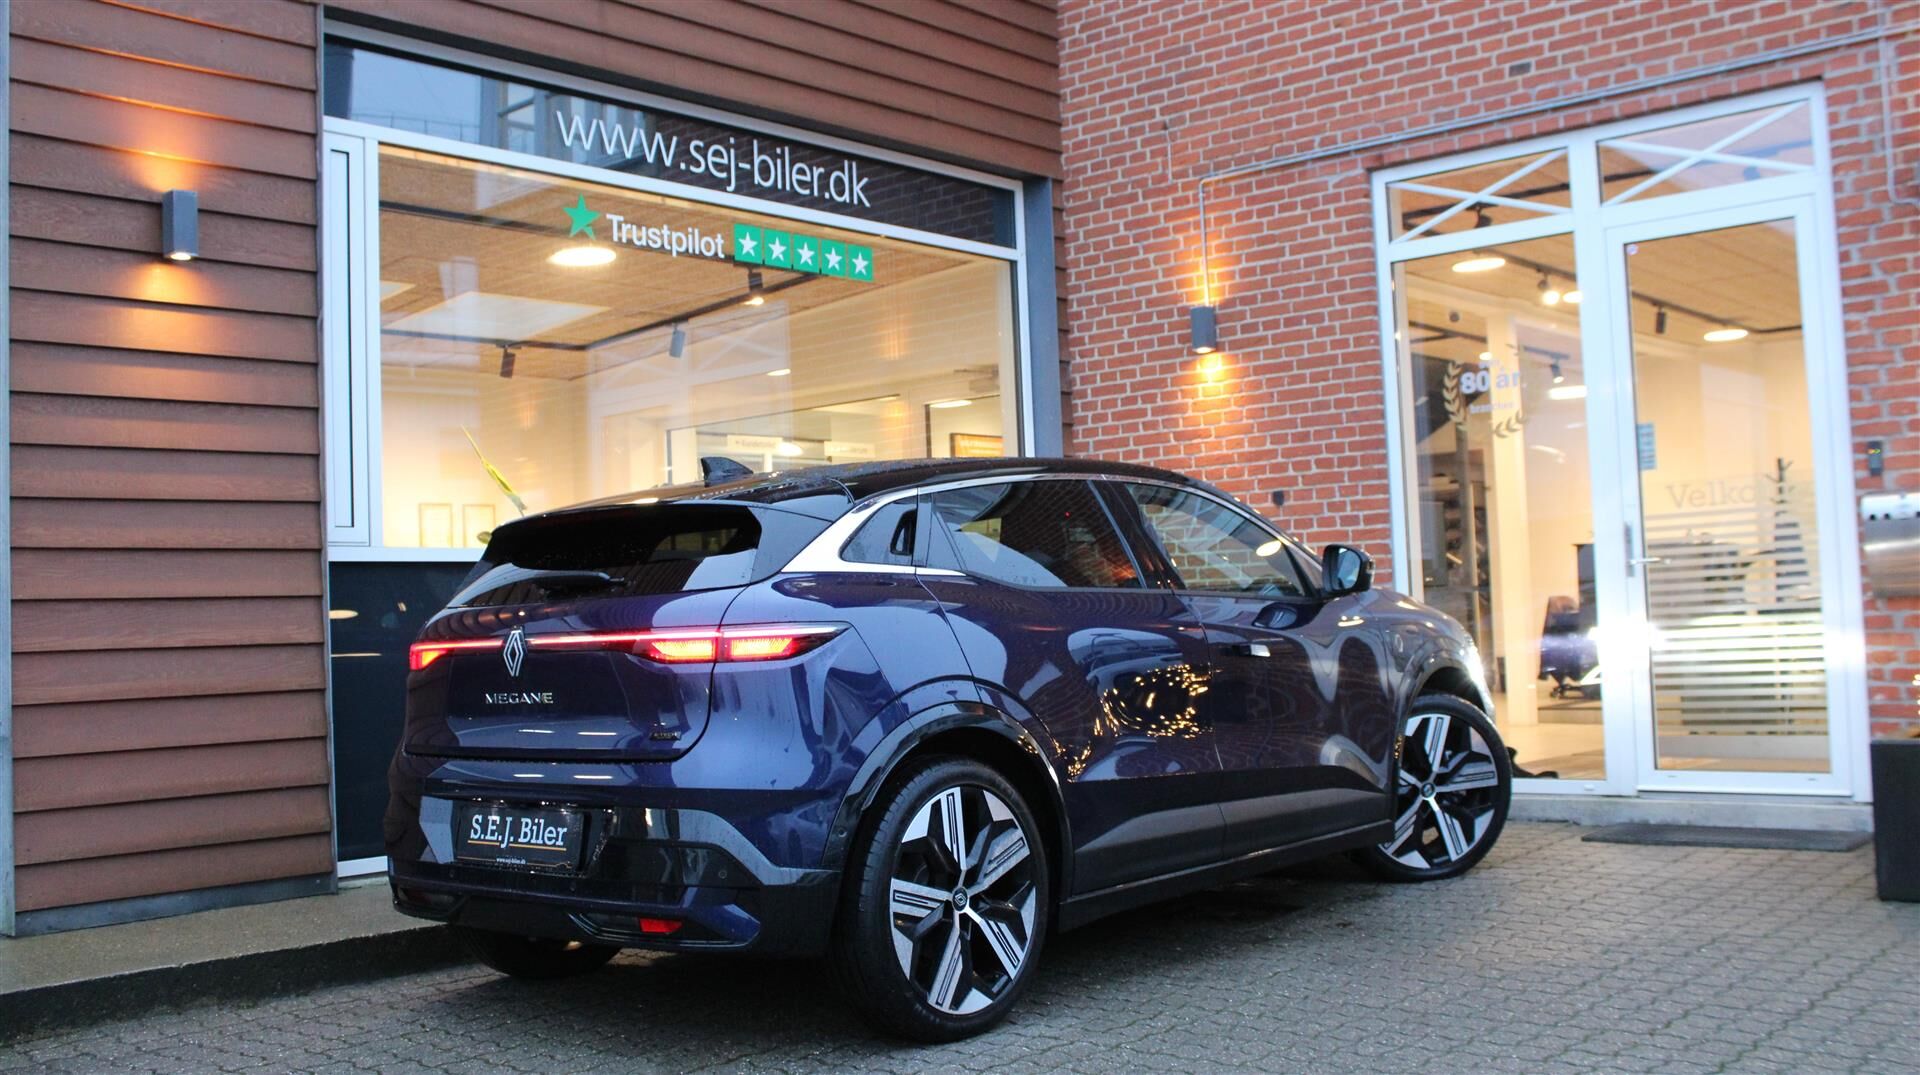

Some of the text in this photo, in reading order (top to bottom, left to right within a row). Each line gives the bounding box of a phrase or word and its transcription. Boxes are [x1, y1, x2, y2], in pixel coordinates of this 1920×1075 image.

[556, 110, 872, 208] www.sej-biler.dk
[605, 212, 726, 258] Trustpilot
[1460, 370, 1490, 395] 80
[485, 692, 554, 705] MEGANE
[470, 814, 568, 849] S.E.J. Biler
